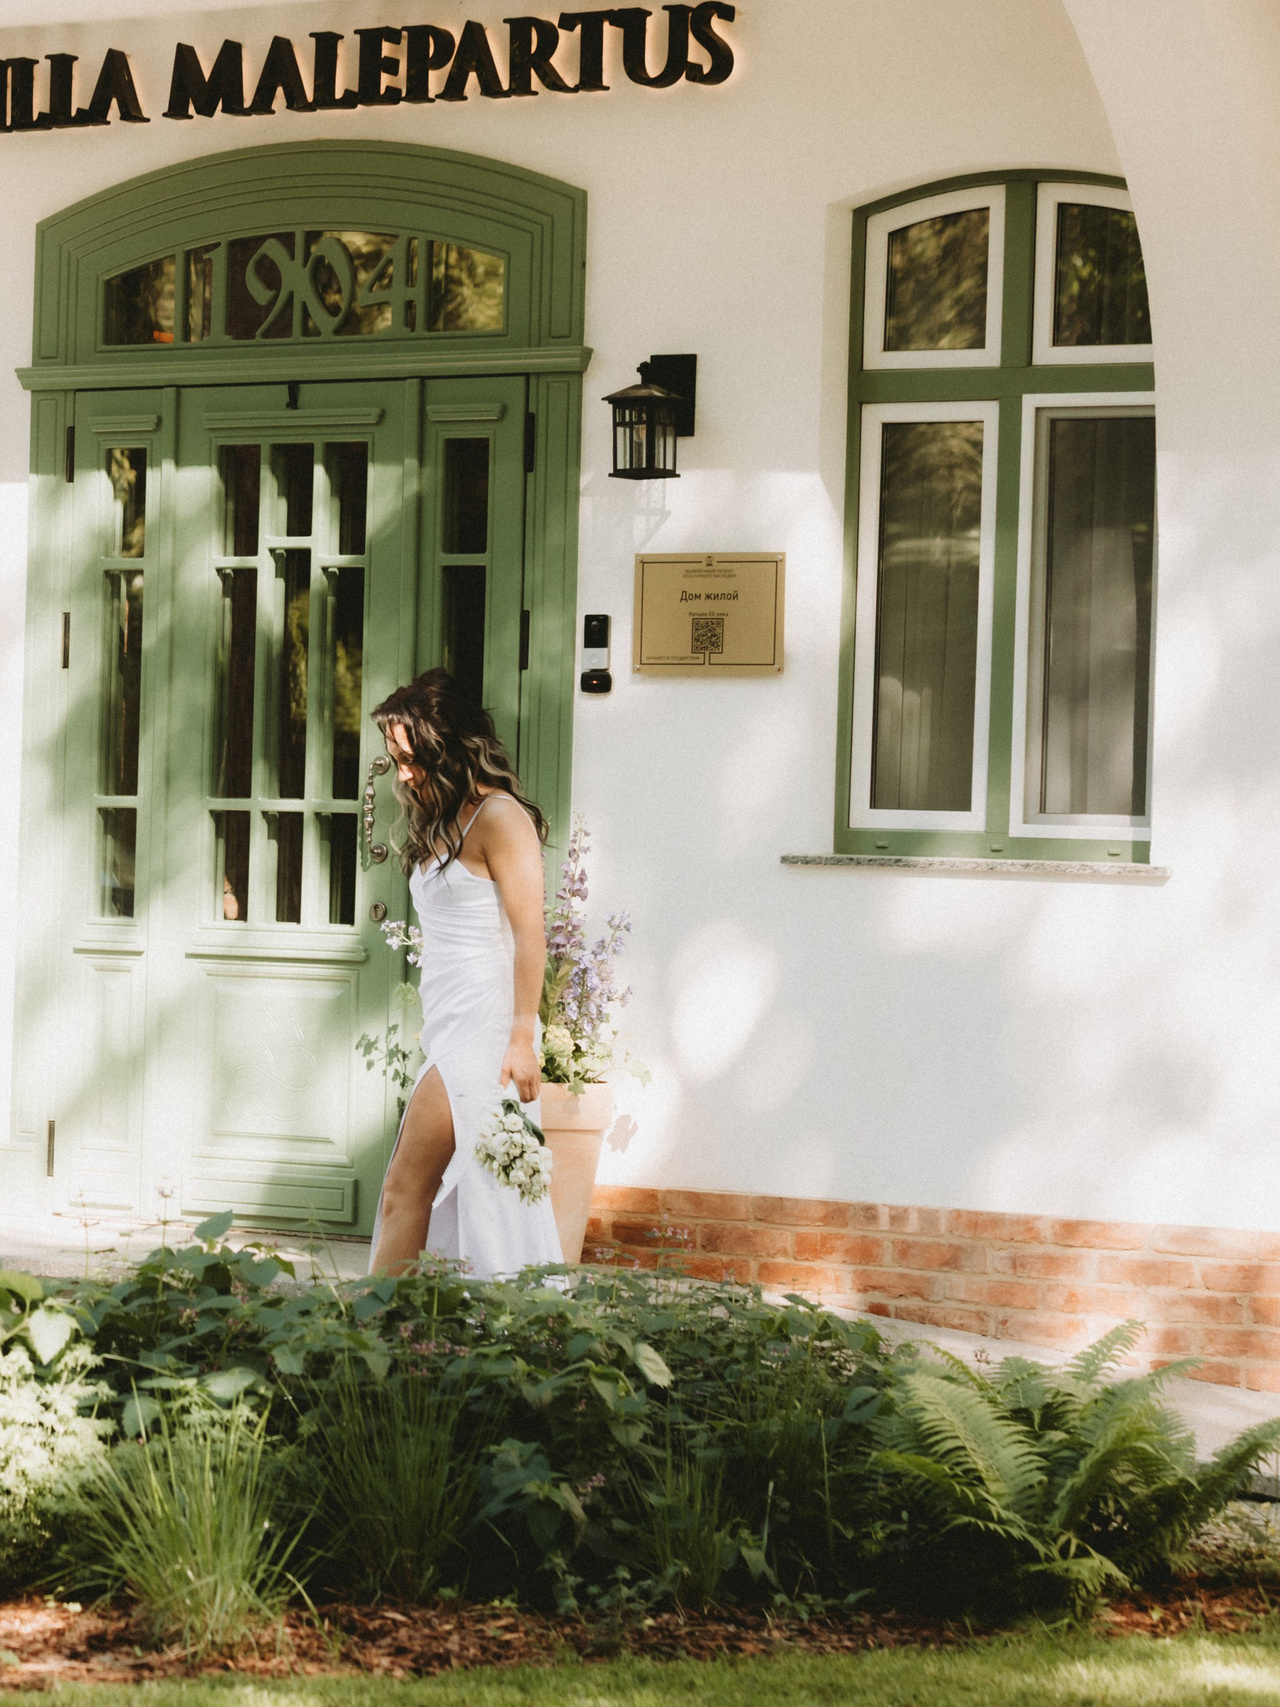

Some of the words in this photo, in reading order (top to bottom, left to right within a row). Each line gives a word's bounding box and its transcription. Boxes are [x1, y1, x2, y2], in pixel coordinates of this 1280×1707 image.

[162, 1, 736, 121] MALEPARTUS
[202, 236, 420, 344] 1904
[680, 590, 702, 603] Дом
[704, 590, 739, 601] жилой
